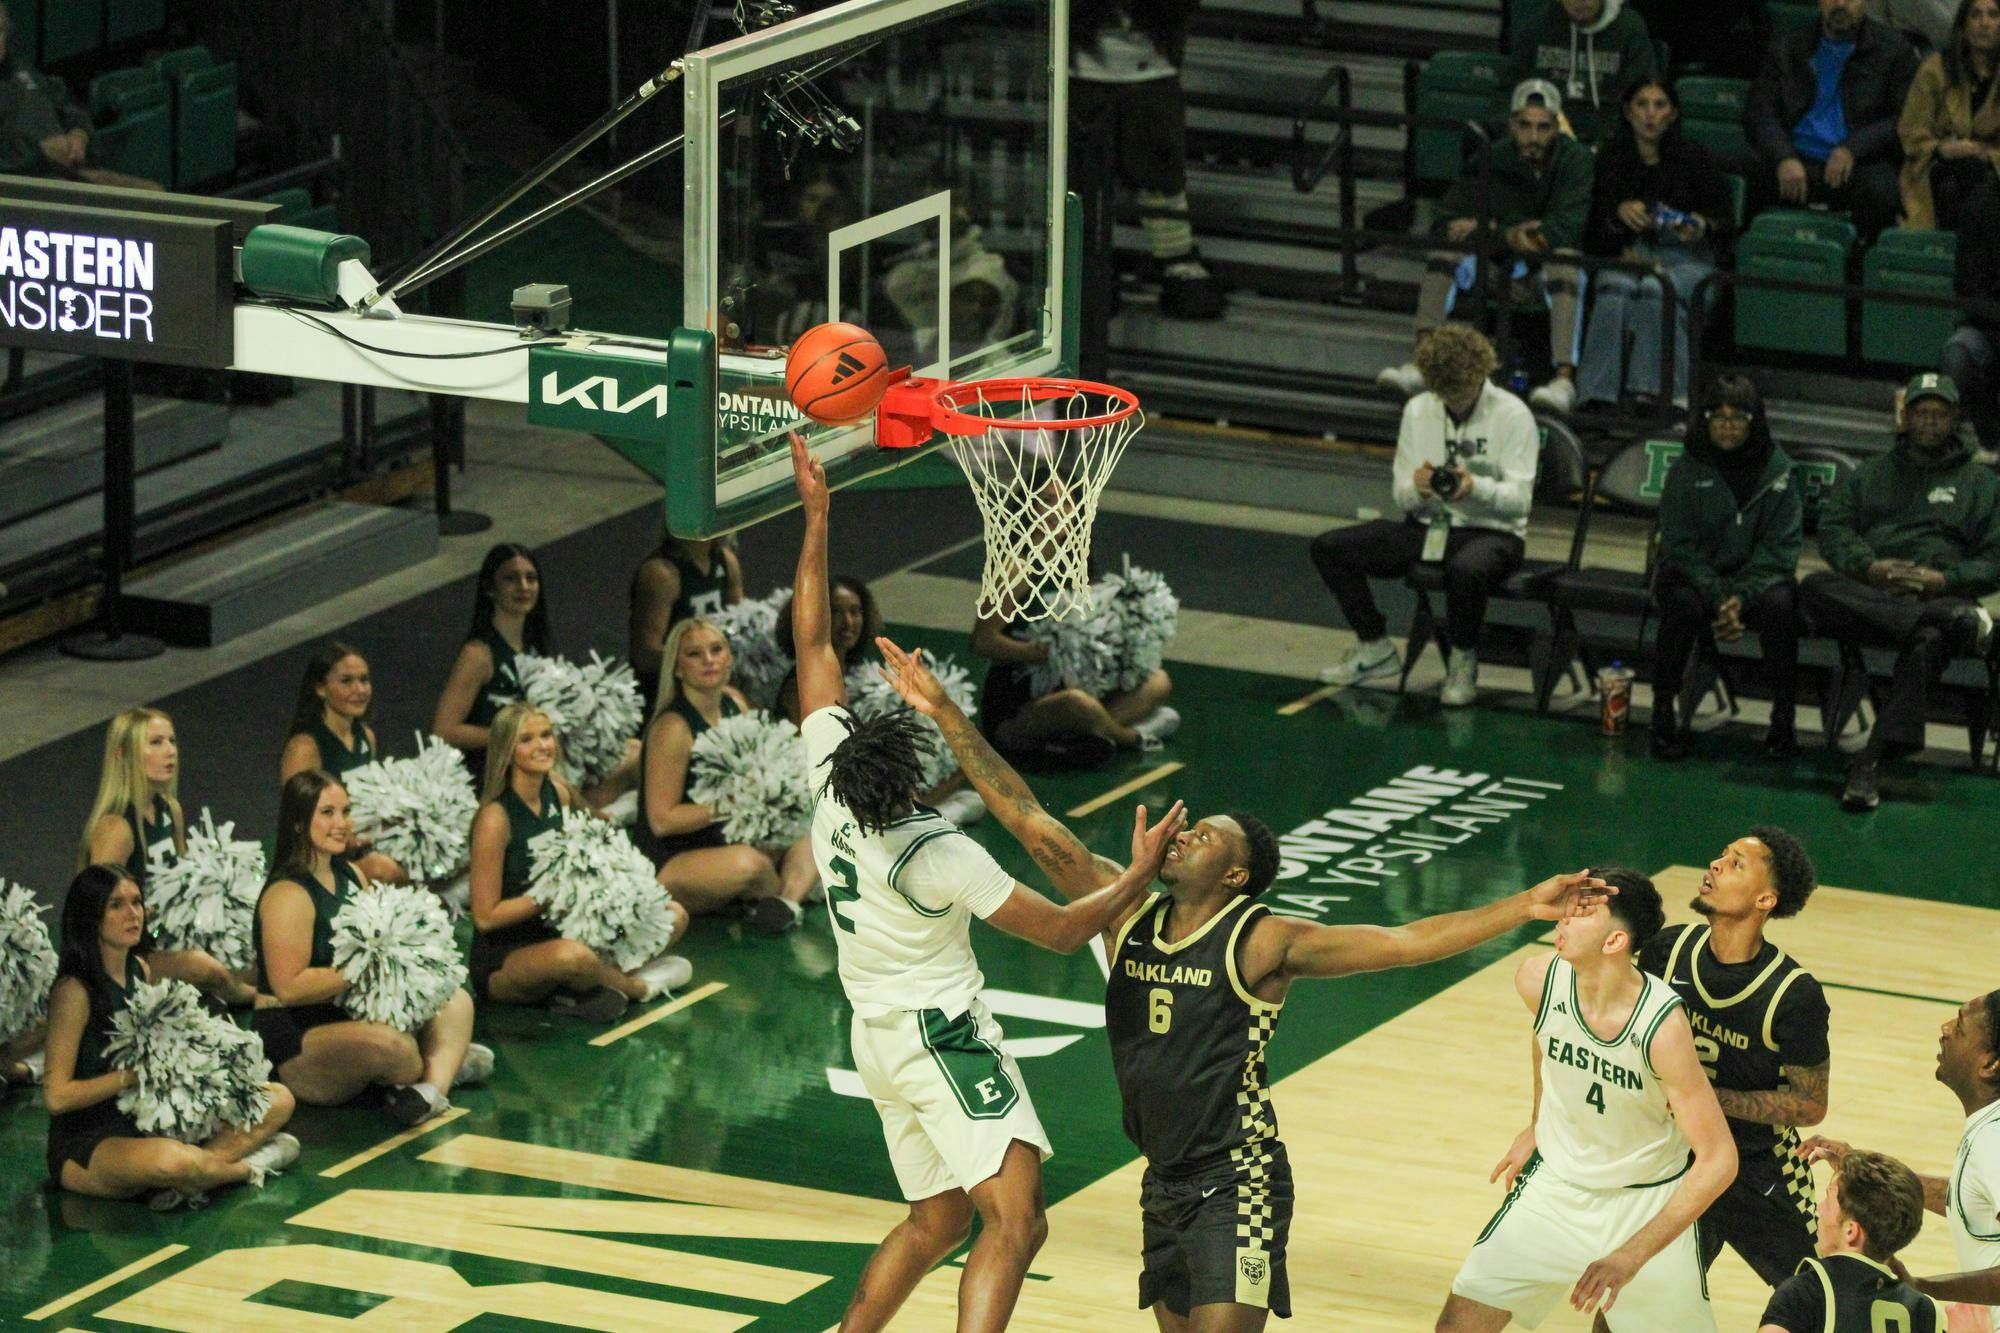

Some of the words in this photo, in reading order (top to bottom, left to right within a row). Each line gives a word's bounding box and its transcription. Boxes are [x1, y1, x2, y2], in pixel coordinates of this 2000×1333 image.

[0, 227, 154, 291] ASTERN
[719, 392, 806, 421] ONTAIN
[1308, 776, 1564, 887] YPSILANTI
[827, 854, 862, 935] 2
[1125, 959, 1212, 987] OAKLAND
[1148, 988, 1174, 1035] 6
[1687, 1007, 1749, 1051] KLAND
[1547, 1036, 1643, 1091] EASTERN
[974, 1076, 1003, 1105] E
[1585, 1081, 1606, 1115] 4
